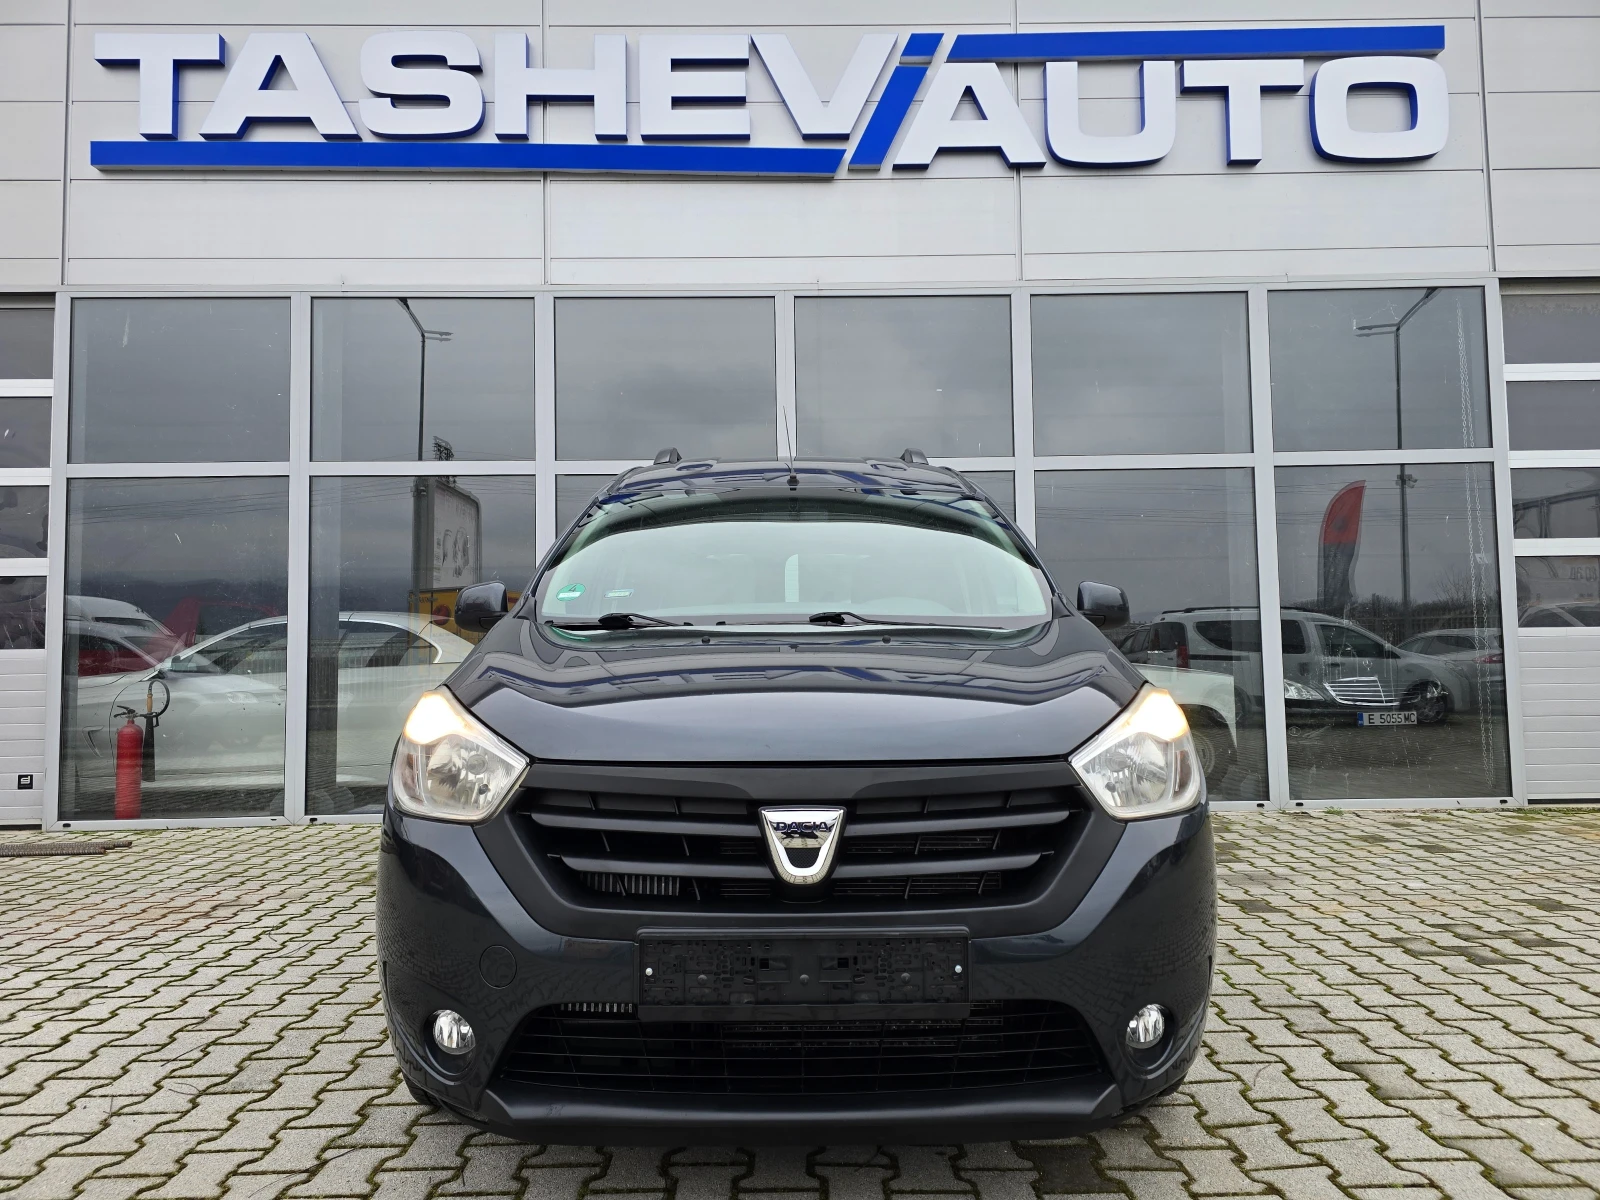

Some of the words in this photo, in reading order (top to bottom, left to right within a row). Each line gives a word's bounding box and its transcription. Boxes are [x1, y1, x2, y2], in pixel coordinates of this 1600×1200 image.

[94, 30, 899, 141] TASHEV
[892, 55, 1449, 169] AUTO
[568, 584, 578, 592] 4
[1368, 713, 1375, 724] E
[1379, 713, 1403, 724] 5055
[1403, 712, 1416, 723] MC
[775, 821, 830, 832] DACIA
